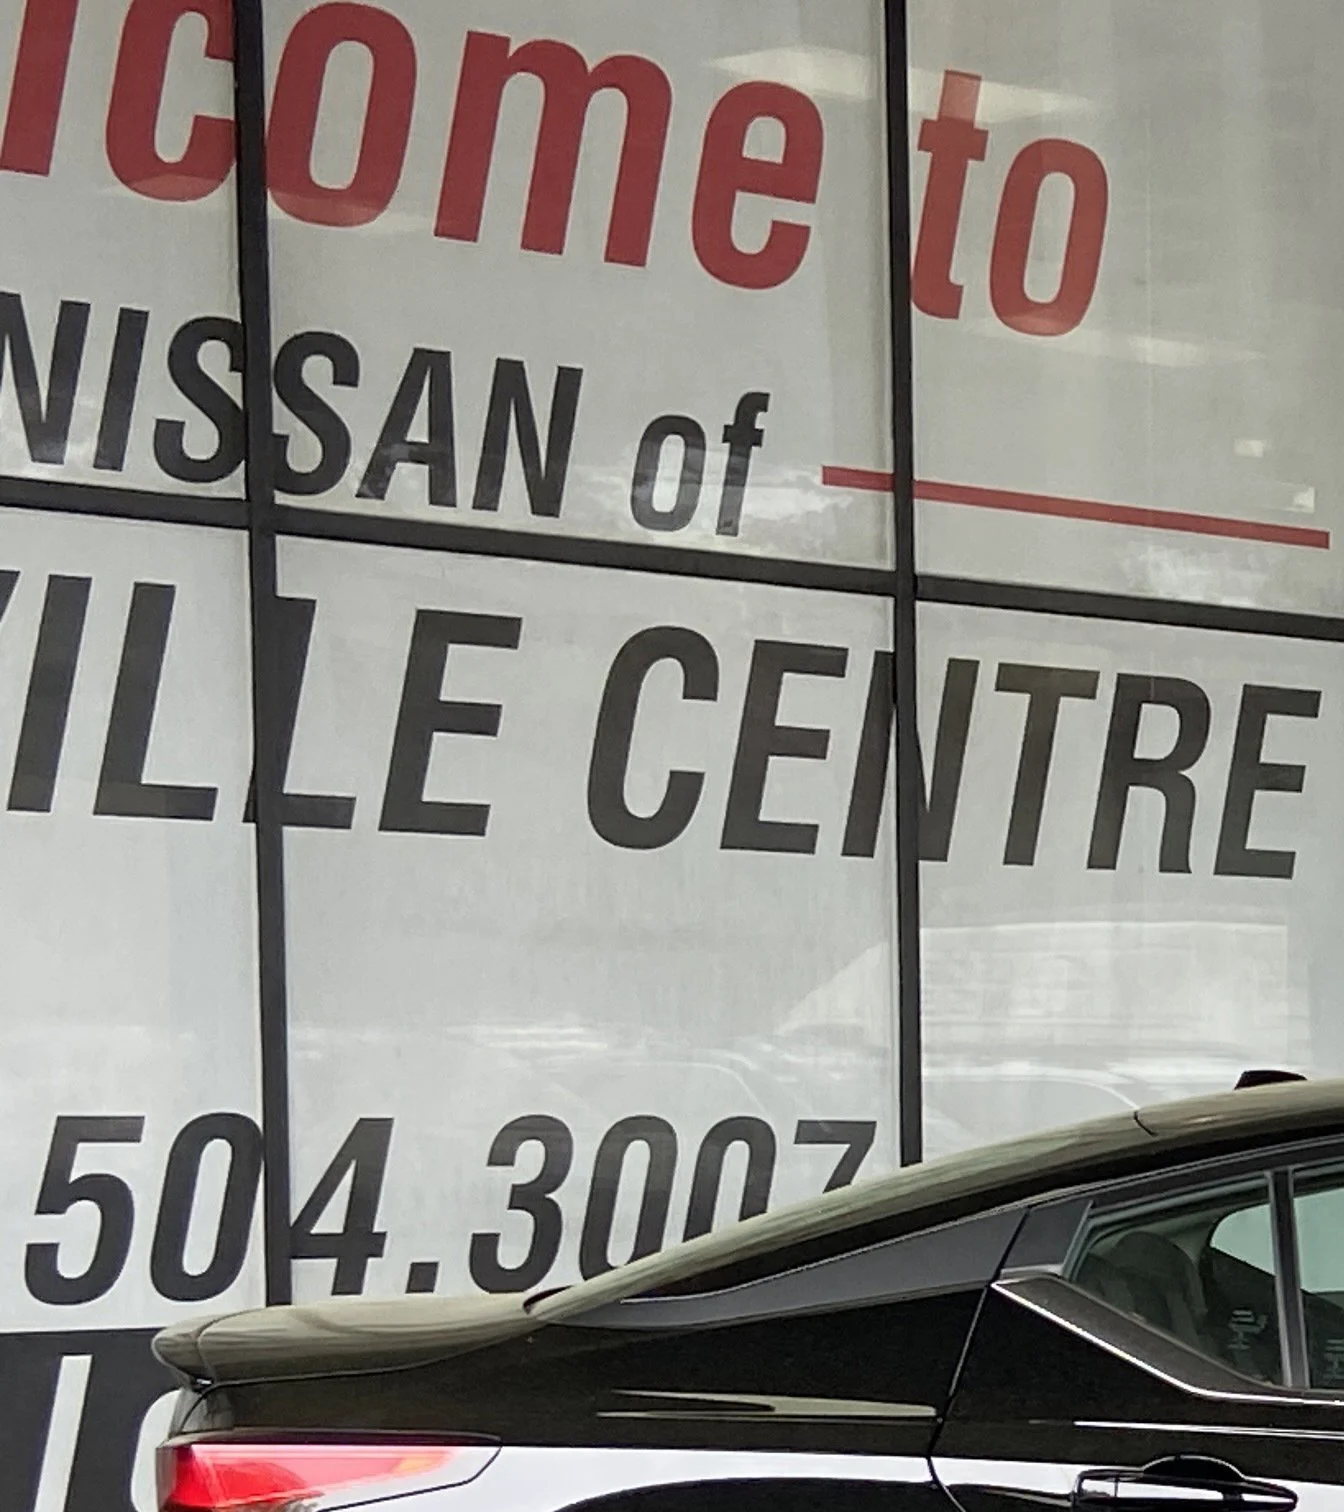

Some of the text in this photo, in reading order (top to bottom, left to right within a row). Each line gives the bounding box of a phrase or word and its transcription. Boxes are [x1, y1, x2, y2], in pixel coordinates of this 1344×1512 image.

[911, 70, 1109, 337] to
[0, 291, 769, 537] NISSAN of
[0, 569, 1323, 881] ILLE CENTRE
